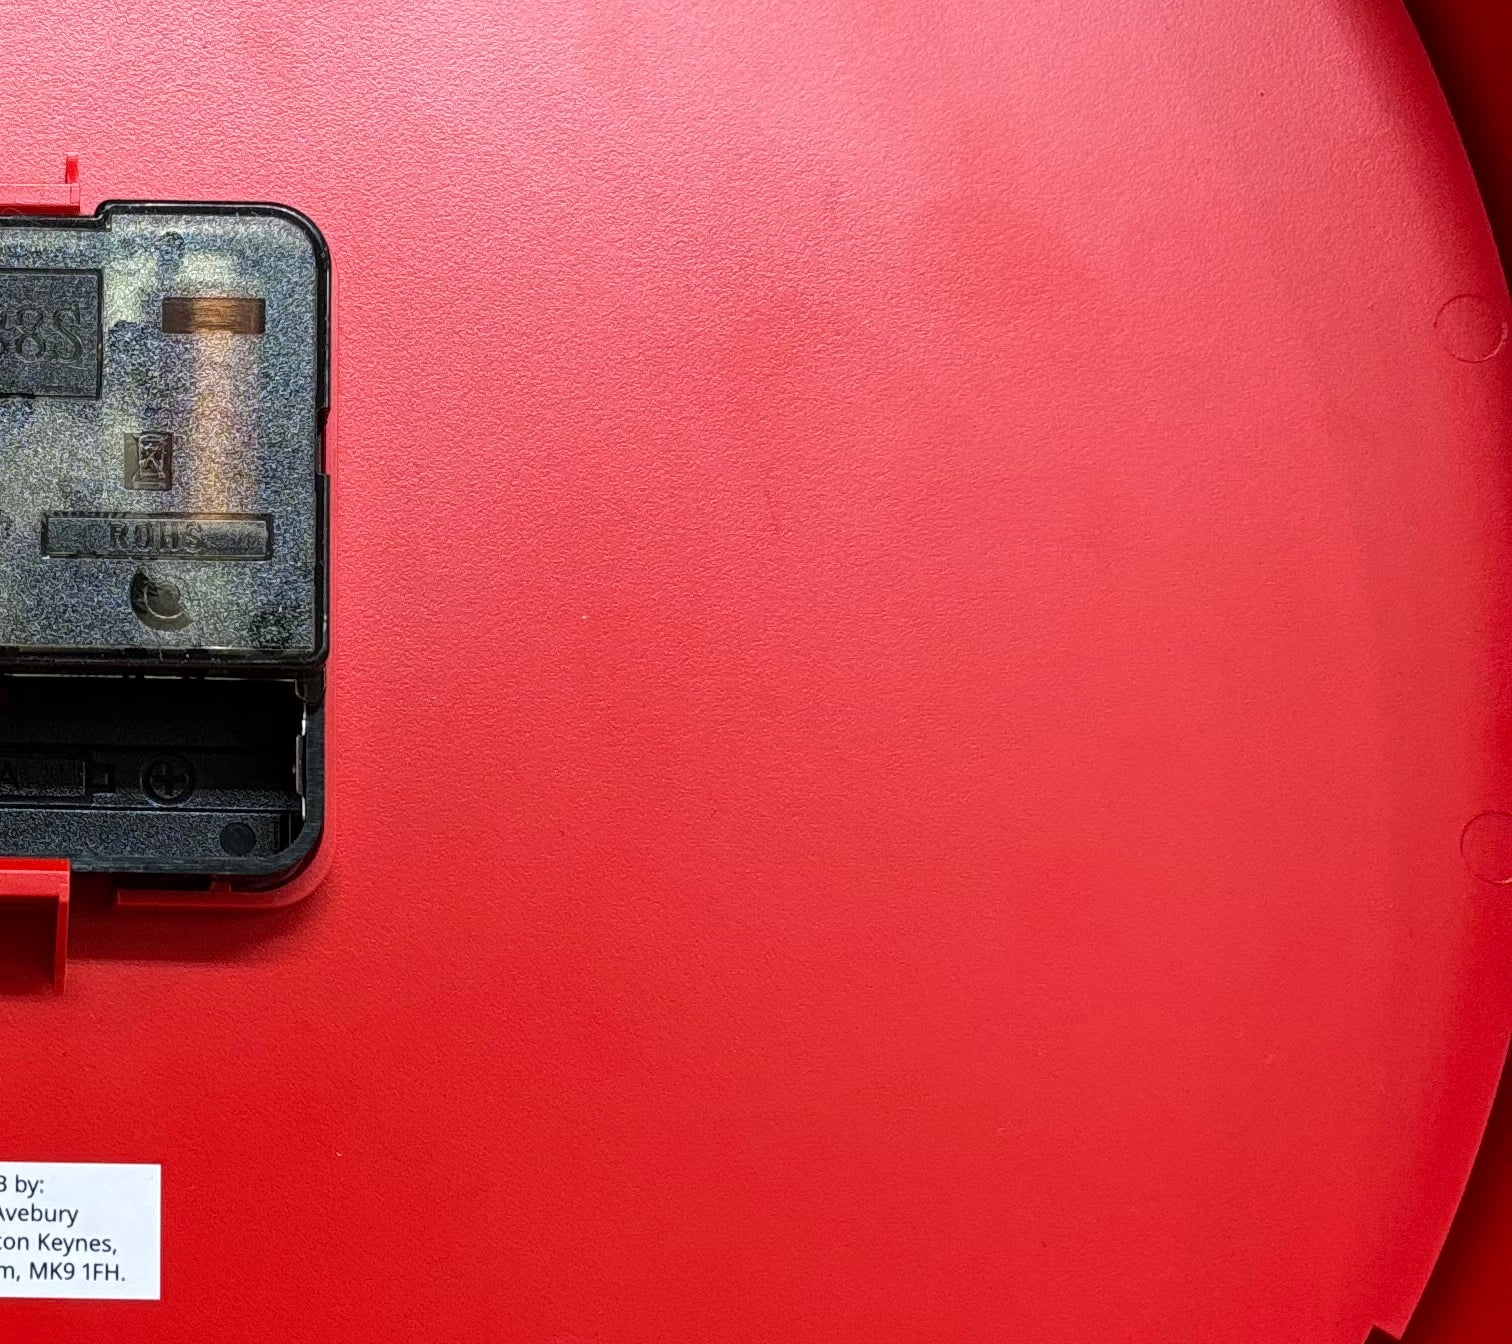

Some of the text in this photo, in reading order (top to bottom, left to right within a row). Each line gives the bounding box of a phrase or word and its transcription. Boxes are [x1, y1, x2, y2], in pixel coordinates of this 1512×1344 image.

[15, 1175, 45, 1199] by:
[38, 1232, 117, 1258] Keynes,
[29, 1261, 75, 1281] MK9
[82, 1262, 126, 1282] 1FH.
